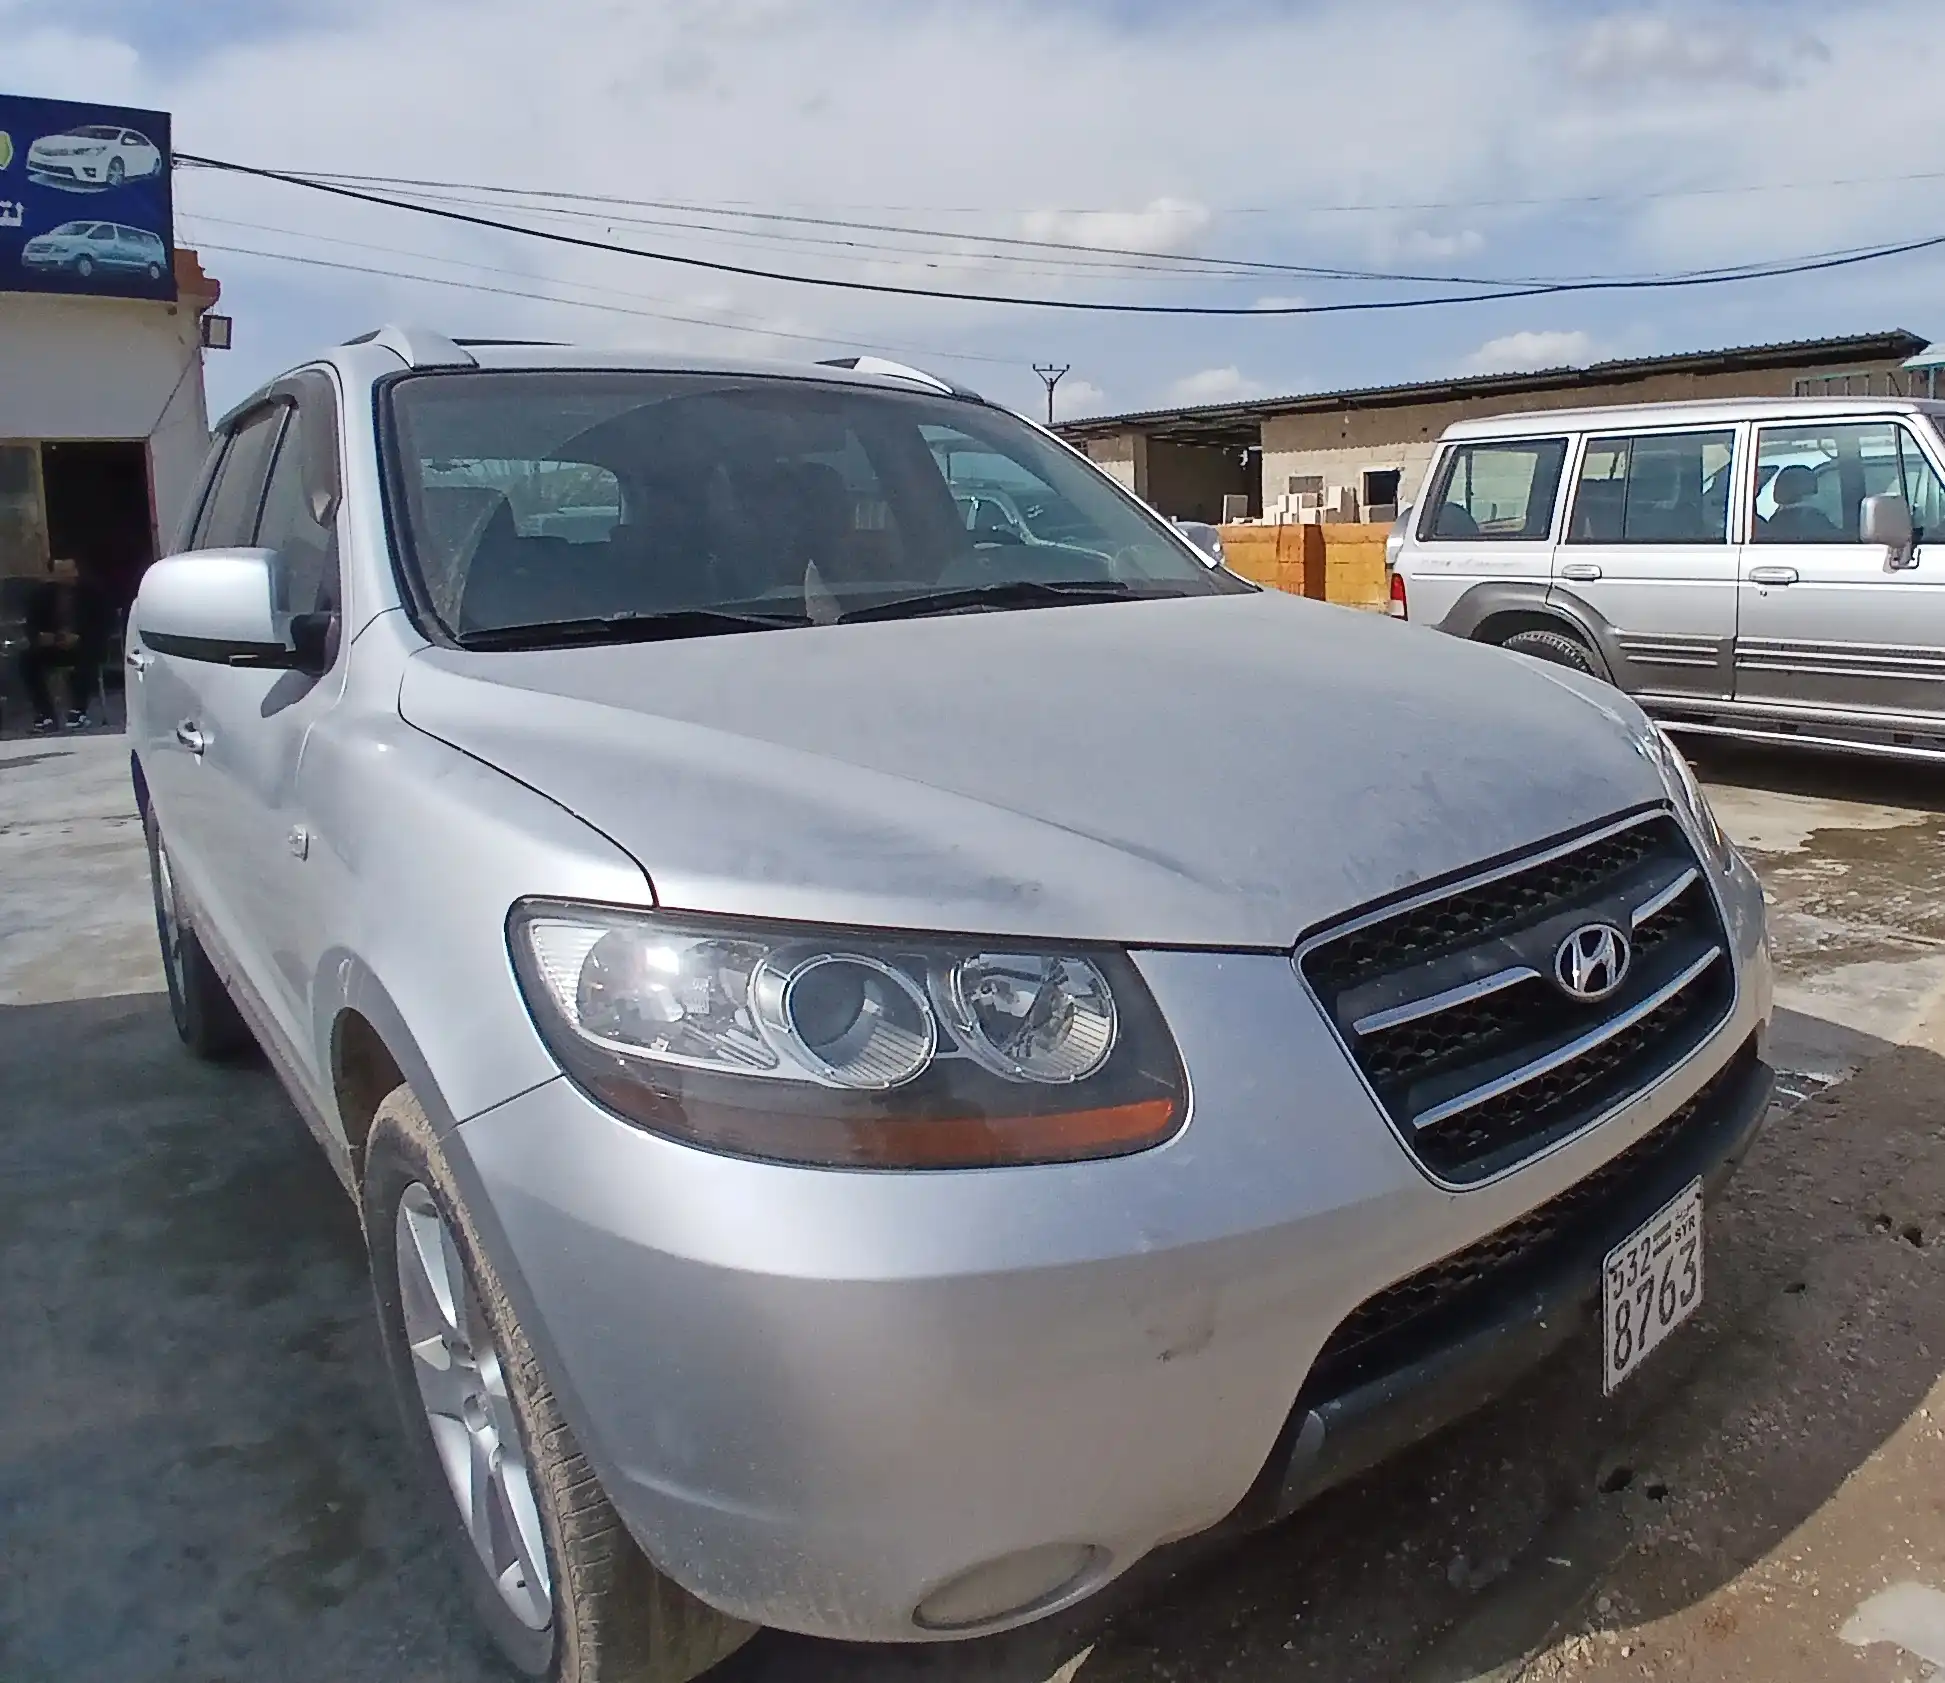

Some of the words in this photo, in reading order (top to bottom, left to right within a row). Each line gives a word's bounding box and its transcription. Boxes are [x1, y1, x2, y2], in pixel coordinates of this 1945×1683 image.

[1674, 1214, 1696, 1243] SYR
[1608, 1236, 1651, 1299] 532
[1613, 1235, 1697, 1371] 8763
